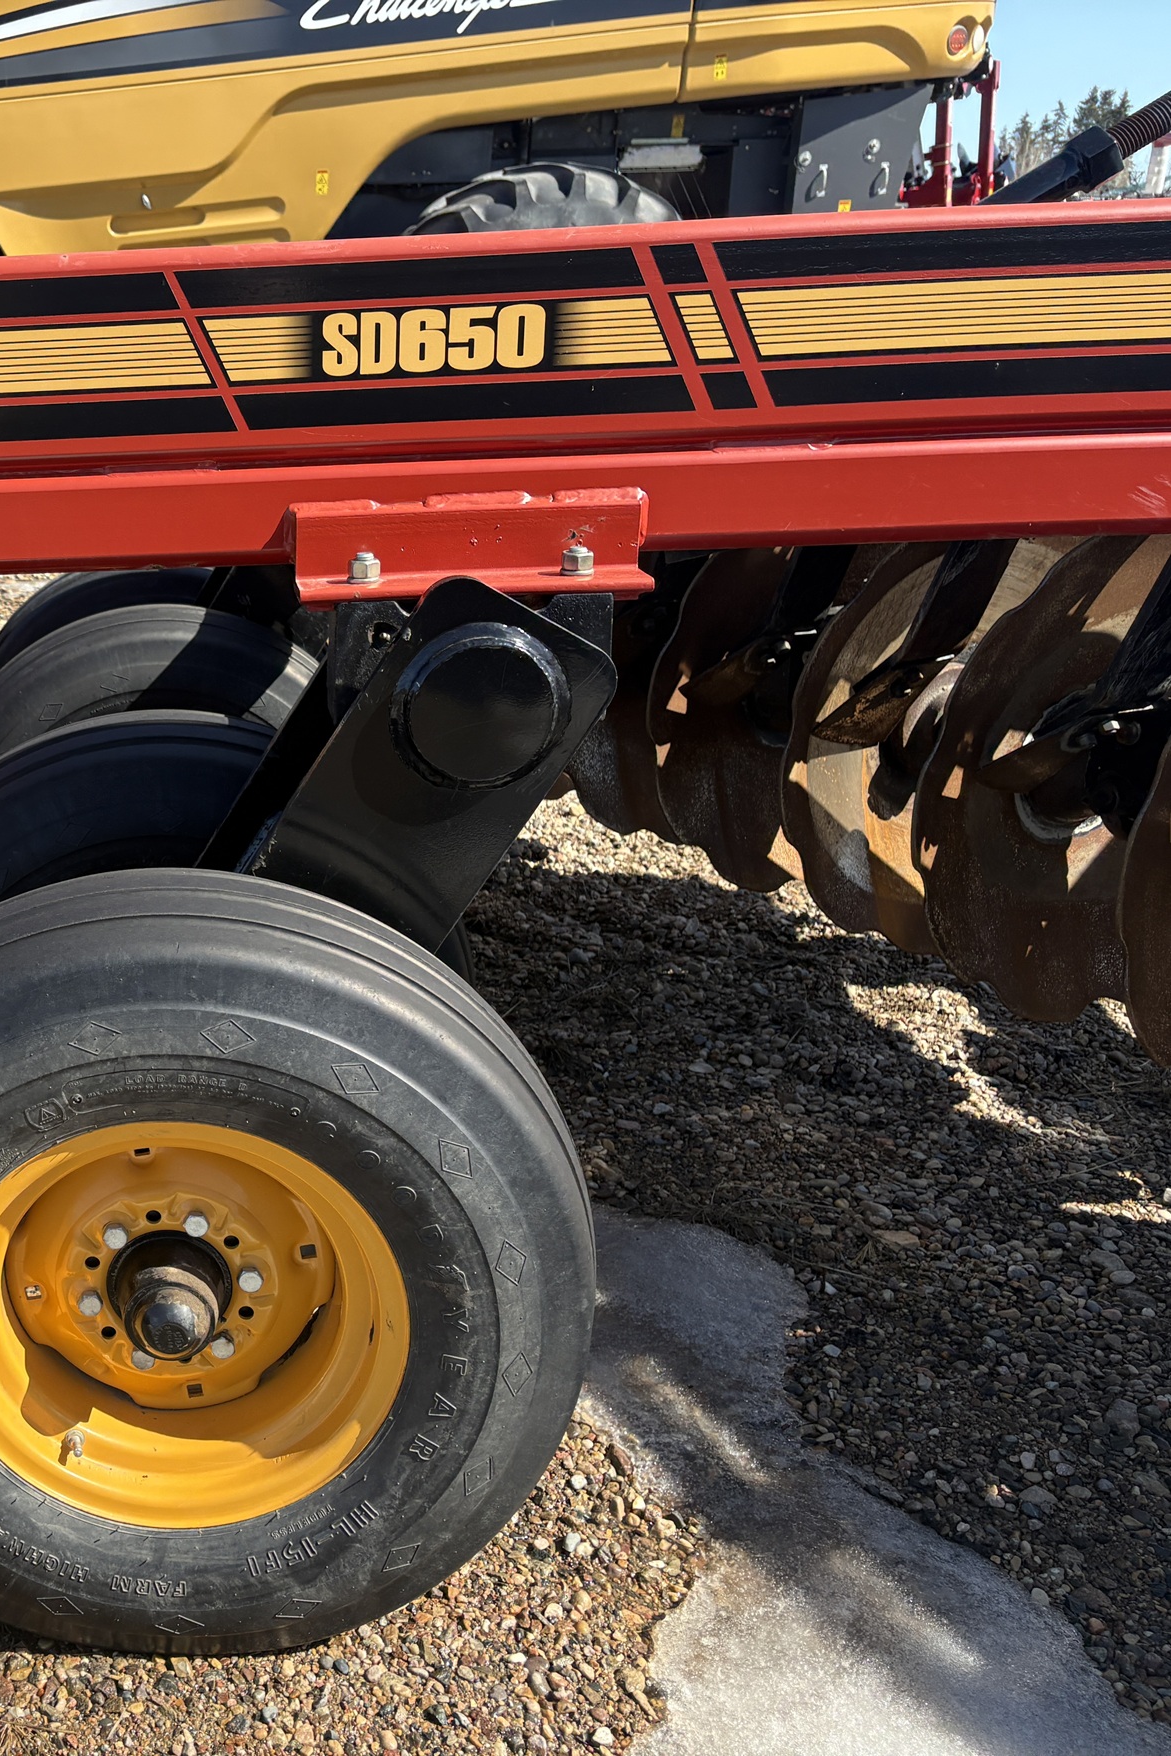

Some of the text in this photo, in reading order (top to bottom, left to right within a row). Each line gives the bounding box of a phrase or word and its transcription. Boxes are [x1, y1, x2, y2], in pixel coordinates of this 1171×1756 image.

[322, 303, 546, 377] SD650
[124, 1073, 166, 1085] LOAD
[177, 1073, 227, 1088] RANGE
[270, 1503, 337, 1541] TUBELESS
[110, 1574, 188, 1598] FARM
